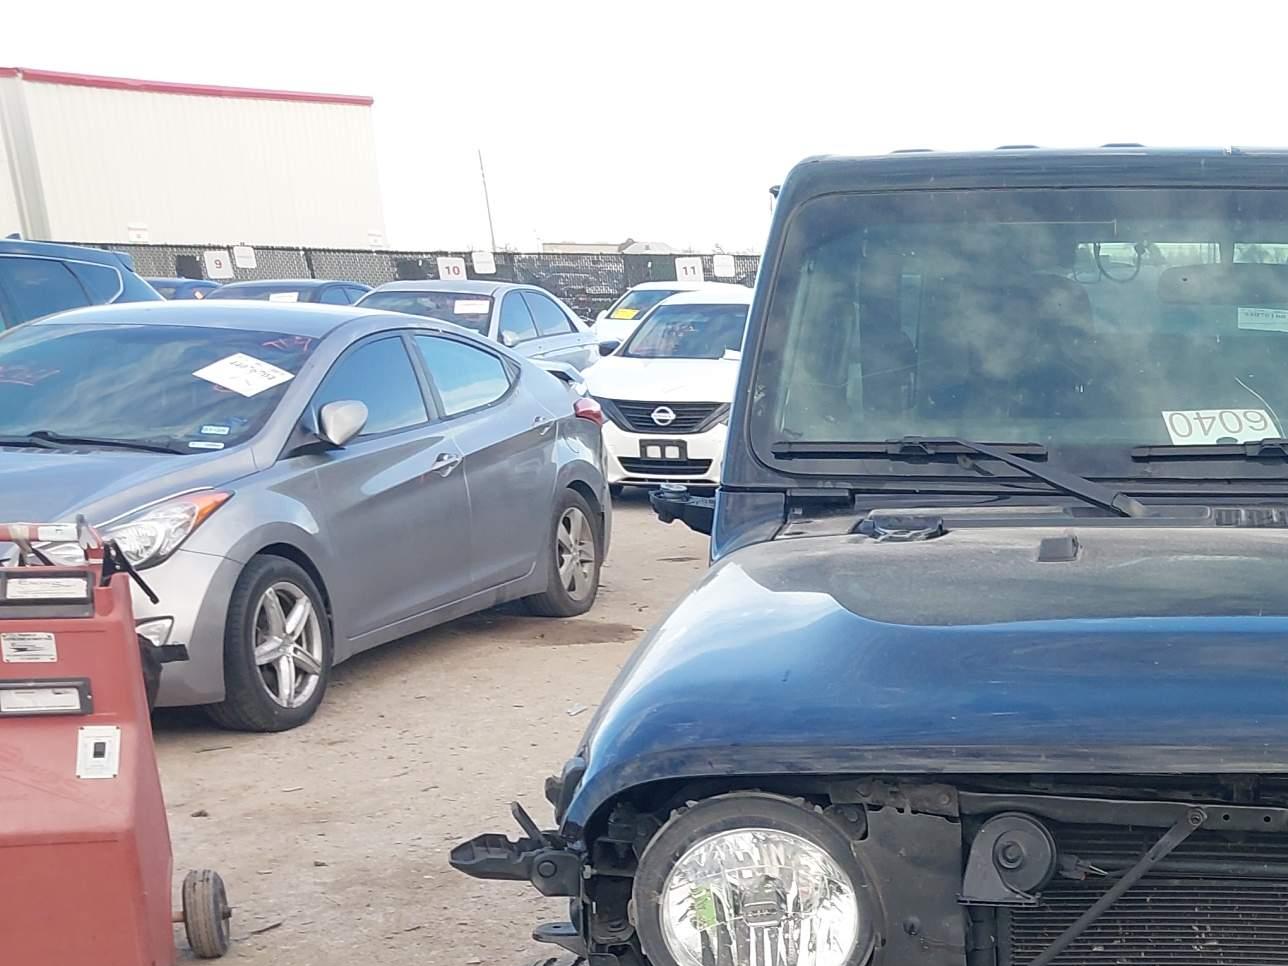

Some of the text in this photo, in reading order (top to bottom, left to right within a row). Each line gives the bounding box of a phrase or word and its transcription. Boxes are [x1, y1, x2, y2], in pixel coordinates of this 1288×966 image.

[214, 259, 223, 269] 9
[445, 265, 461, 276] 10
[682, 266, 696, 276] 11
[1168, 410, 1269, 439] 6040
